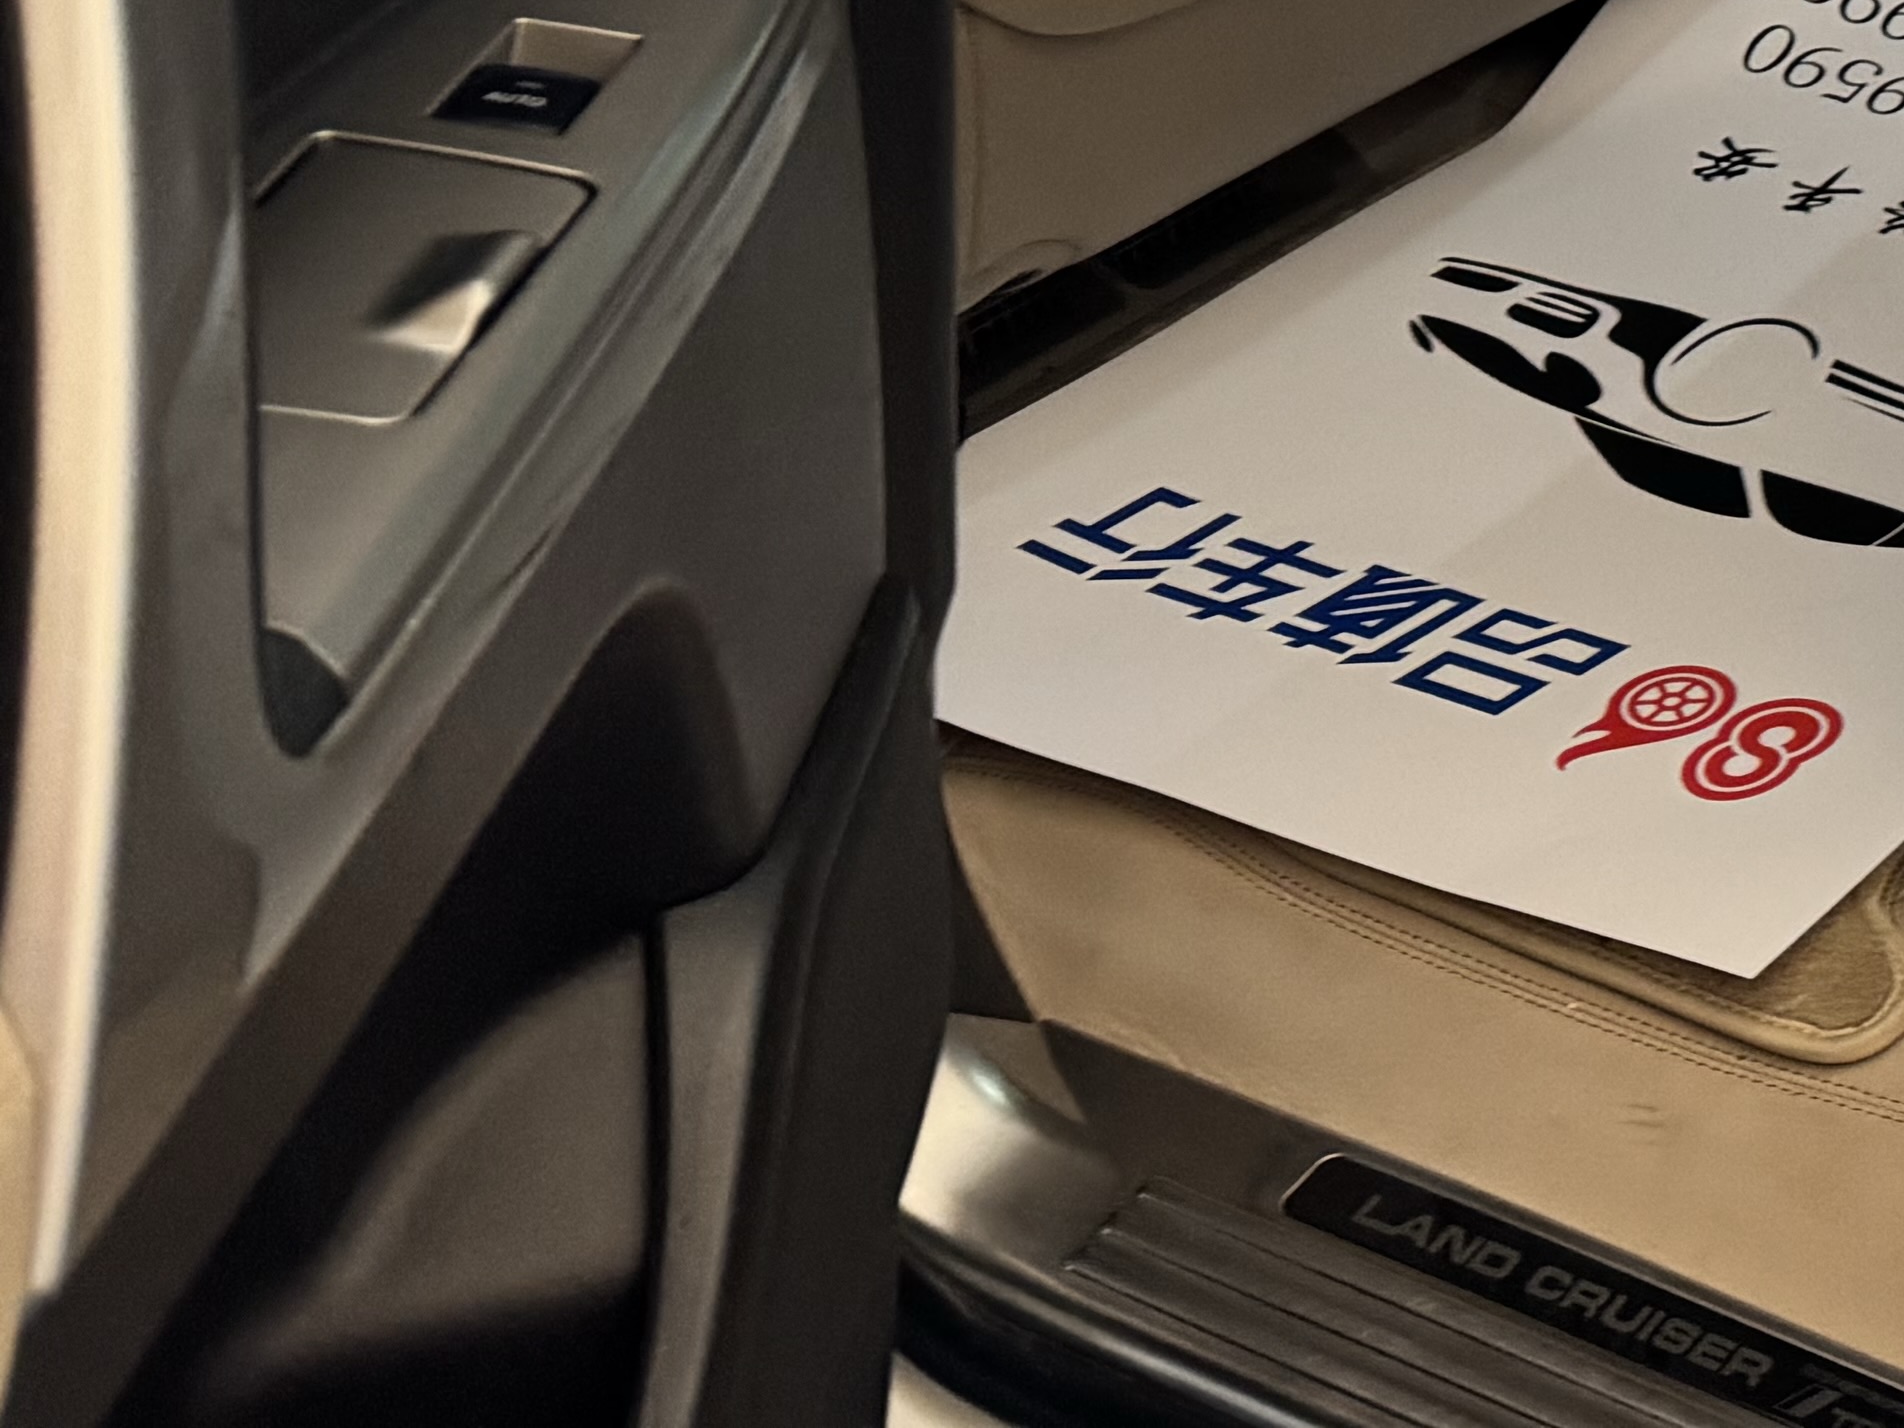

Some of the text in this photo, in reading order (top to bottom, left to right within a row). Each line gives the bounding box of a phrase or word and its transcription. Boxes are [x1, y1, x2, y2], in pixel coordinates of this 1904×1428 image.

[1017, 485, 1632, 717] 品值车行
[1352, 1193, 1775, 1388] LAND CRUISER
